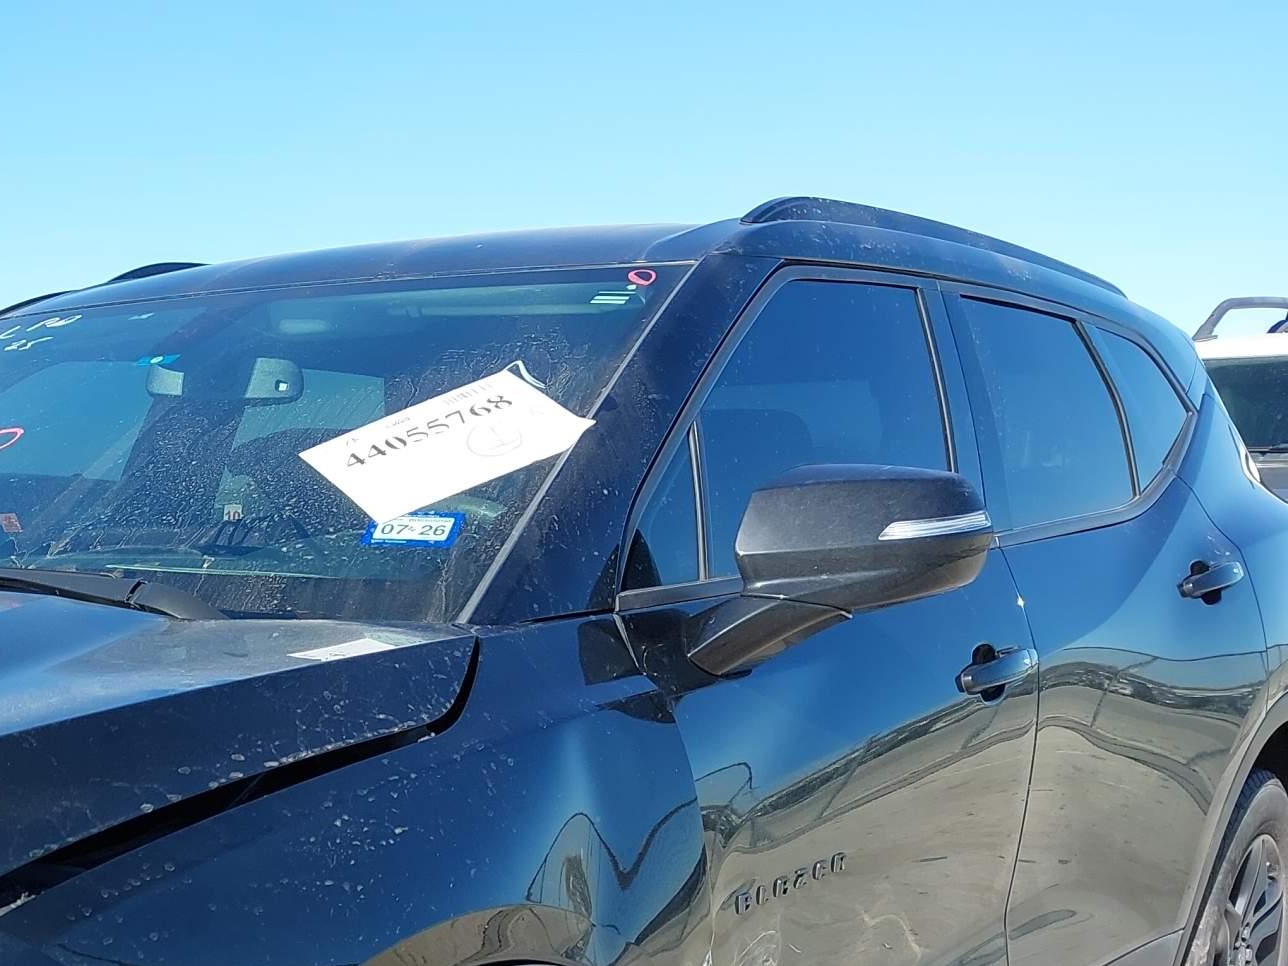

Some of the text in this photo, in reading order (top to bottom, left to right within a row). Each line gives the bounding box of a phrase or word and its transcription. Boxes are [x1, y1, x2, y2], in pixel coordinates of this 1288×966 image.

[345, 394, 514, 469] 44055768
[380, 523, 447, 536] 07 26
[734, 851, 848, 915] BLAZER
